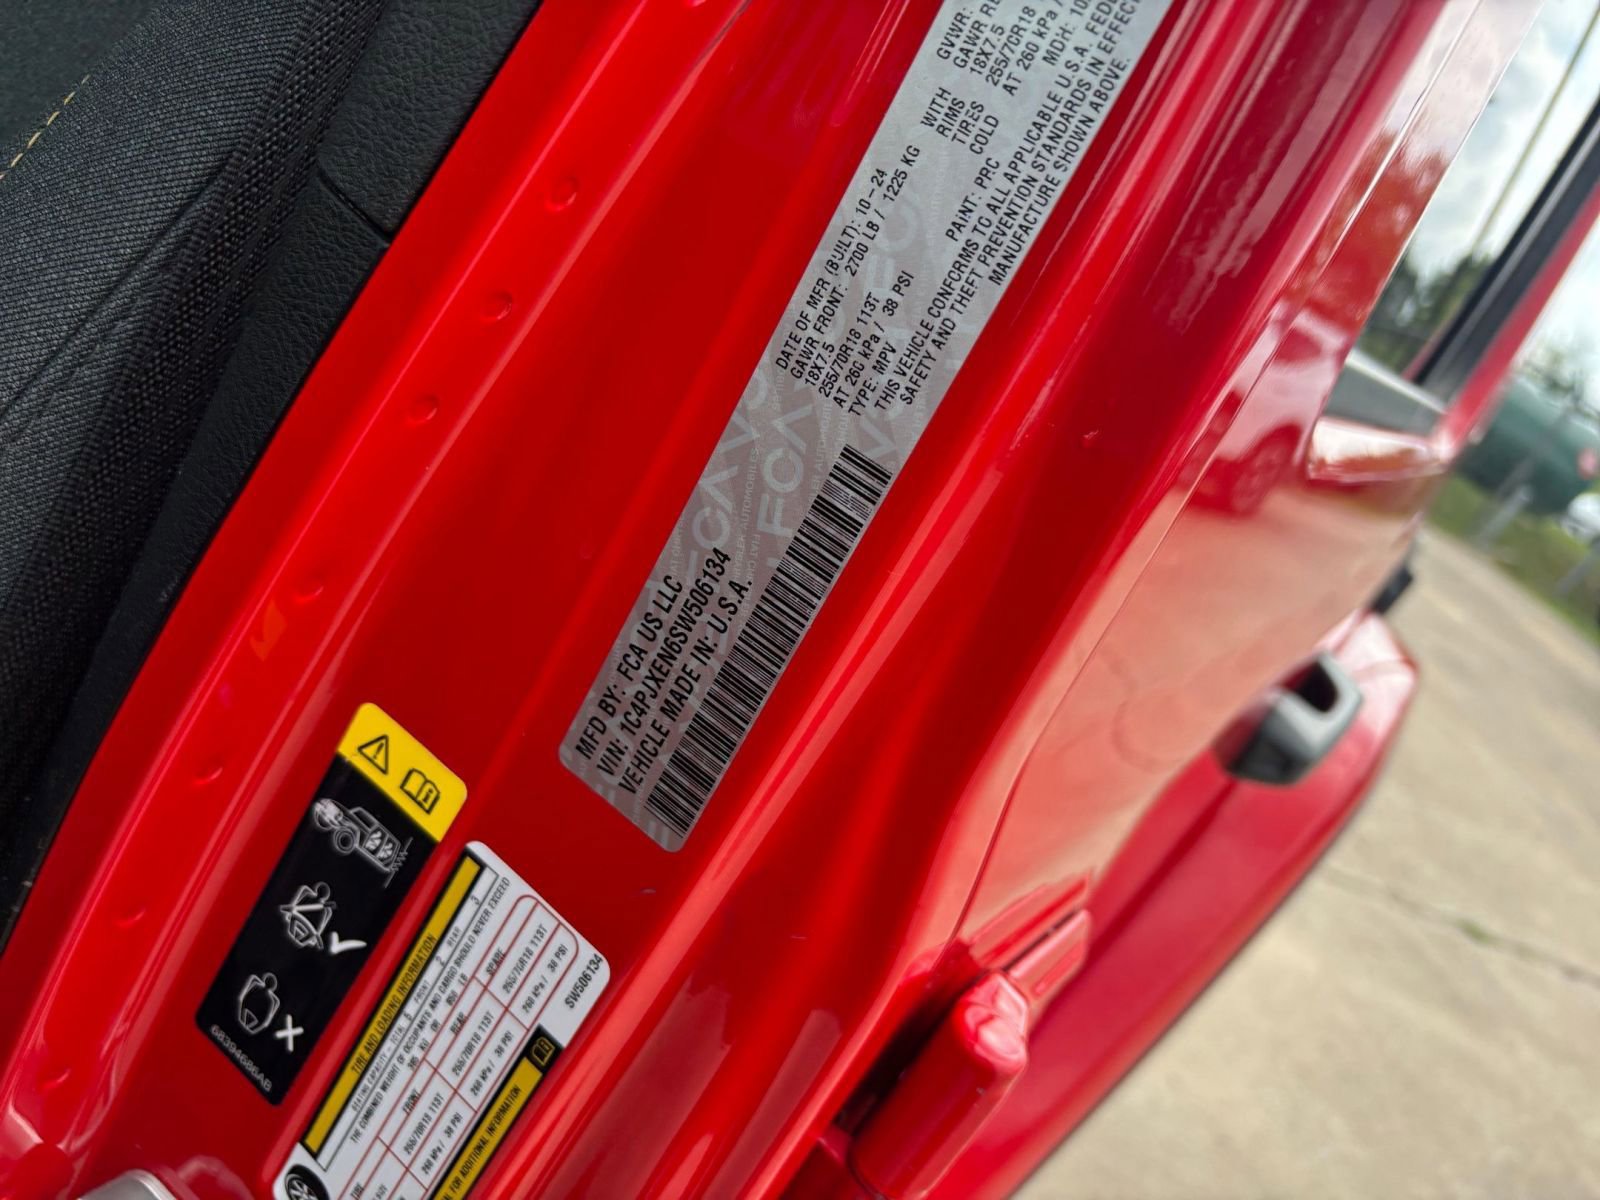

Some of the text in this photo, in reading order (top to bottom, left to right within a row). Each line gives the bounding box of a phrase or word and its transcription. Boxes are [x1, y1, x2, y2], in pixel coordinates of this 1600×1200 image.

[935, 5, 973, 60] GVWR:
[952, 18, 988, 69] GAWR
[968, 22, 1006, 77] 18X7.5
[983, 4, 1037, 87] 255/70R18
[1000, 72, 1023, 96] AT
[1014, 40, 1041, 71] 260
[1031, 7, 1059, 39] kPa
[1041, 20, 1077, 66] MDH:
[944, 156, 1001, 242] PAINT: PRC
[987, 52, 1131, 286] MANUFACTURE SHOWN ABOVE.
[788, 334, 820, 379] GAWR
[812, 281, 848, 335] FRONT:
[842, 241, 870, 277] 2700
[862, 219, 881, 241] LB
[881, 167, 909, 204] 1225
[901, 143, 922, 167] KG
[920, 86, 952, 129] WITH
[803, 340, 836, 388] 18X7.5
[935, 96, 966, 137] RIMS
[816, 327, 863, 398] 255/70R18
[854, 291, 881, 326] 113T
[951, 99, 986, 146] TIRES
[831, 385, 851, 408] AT
[842, 359, 865, 386] 260
[857, 331, 880, 360] kPa
[880, 296, 899, 317] 38
[891, 269, 914, 297] PSI
[968, 113, 1000, 155] COLD
[873, 377, 901, 413] THIS
[892, 318, 935, 378] VEHICLE
[925, 237, 980, 319] CONFORMS
[971, 214, 993, 238] TO
[983, 183, 1011, 215] ALL
[1001, 90, 1063, 184] APPLICABLE
[1054, 37, 1093, 90] U.S.A.
[898, 349, 938, 406] SAFETY
[929, 316, 957, 351] AND
[949, 267, 985, 316] THEFT
[976, 172, 1039, 267] PREVENTION
[1029, 77, 1094, 173] STANDARDS
[1084, 55, 1106, 76] IN
[774, 331, 802, 370] DATE
[794, 310, 813, 332] OF
[805, 276, 831, 310] MFR
[823, 218, 863, 277] (BUILT):
[847, 341, 898, 418] TYPE: MPV
[574, 714, 608, 761] MFD
[597, 679, 627, 718] BY:
[616, 639, 648, 682] FCA
[636, 610, 664, 643] US
[651, 572, 684, 614] LLC
[596, 545, 732, 779] VIN: 1C4PJXEN6SW506134
[618, 570, 752, 797] VEHICLE MADE IN: U.S.A.
[434, 954, 445, 966] 2
[470, 893, 481, 906] 3
[484, 946, 506, 976] SPARE
[563, 952, 604, 1010] SW506134
[349, 875, 511, 1144] THE COMBINED WEIGHT OF OCCUPANTS AND CARGO SHOULD NEVER EXCEED
[350, 932, 437, 1076] TIRE AND LOADING INFORMATION
[449, 1010, 467, 1035] REAR
[401, 1087, 421, 1115] FRONT
[449, 1175, 463, 1194] FOR
[458, 1134, 489, 1179] ADDITIONAL
[485, 1083, 521, 1137] INFORMATION
